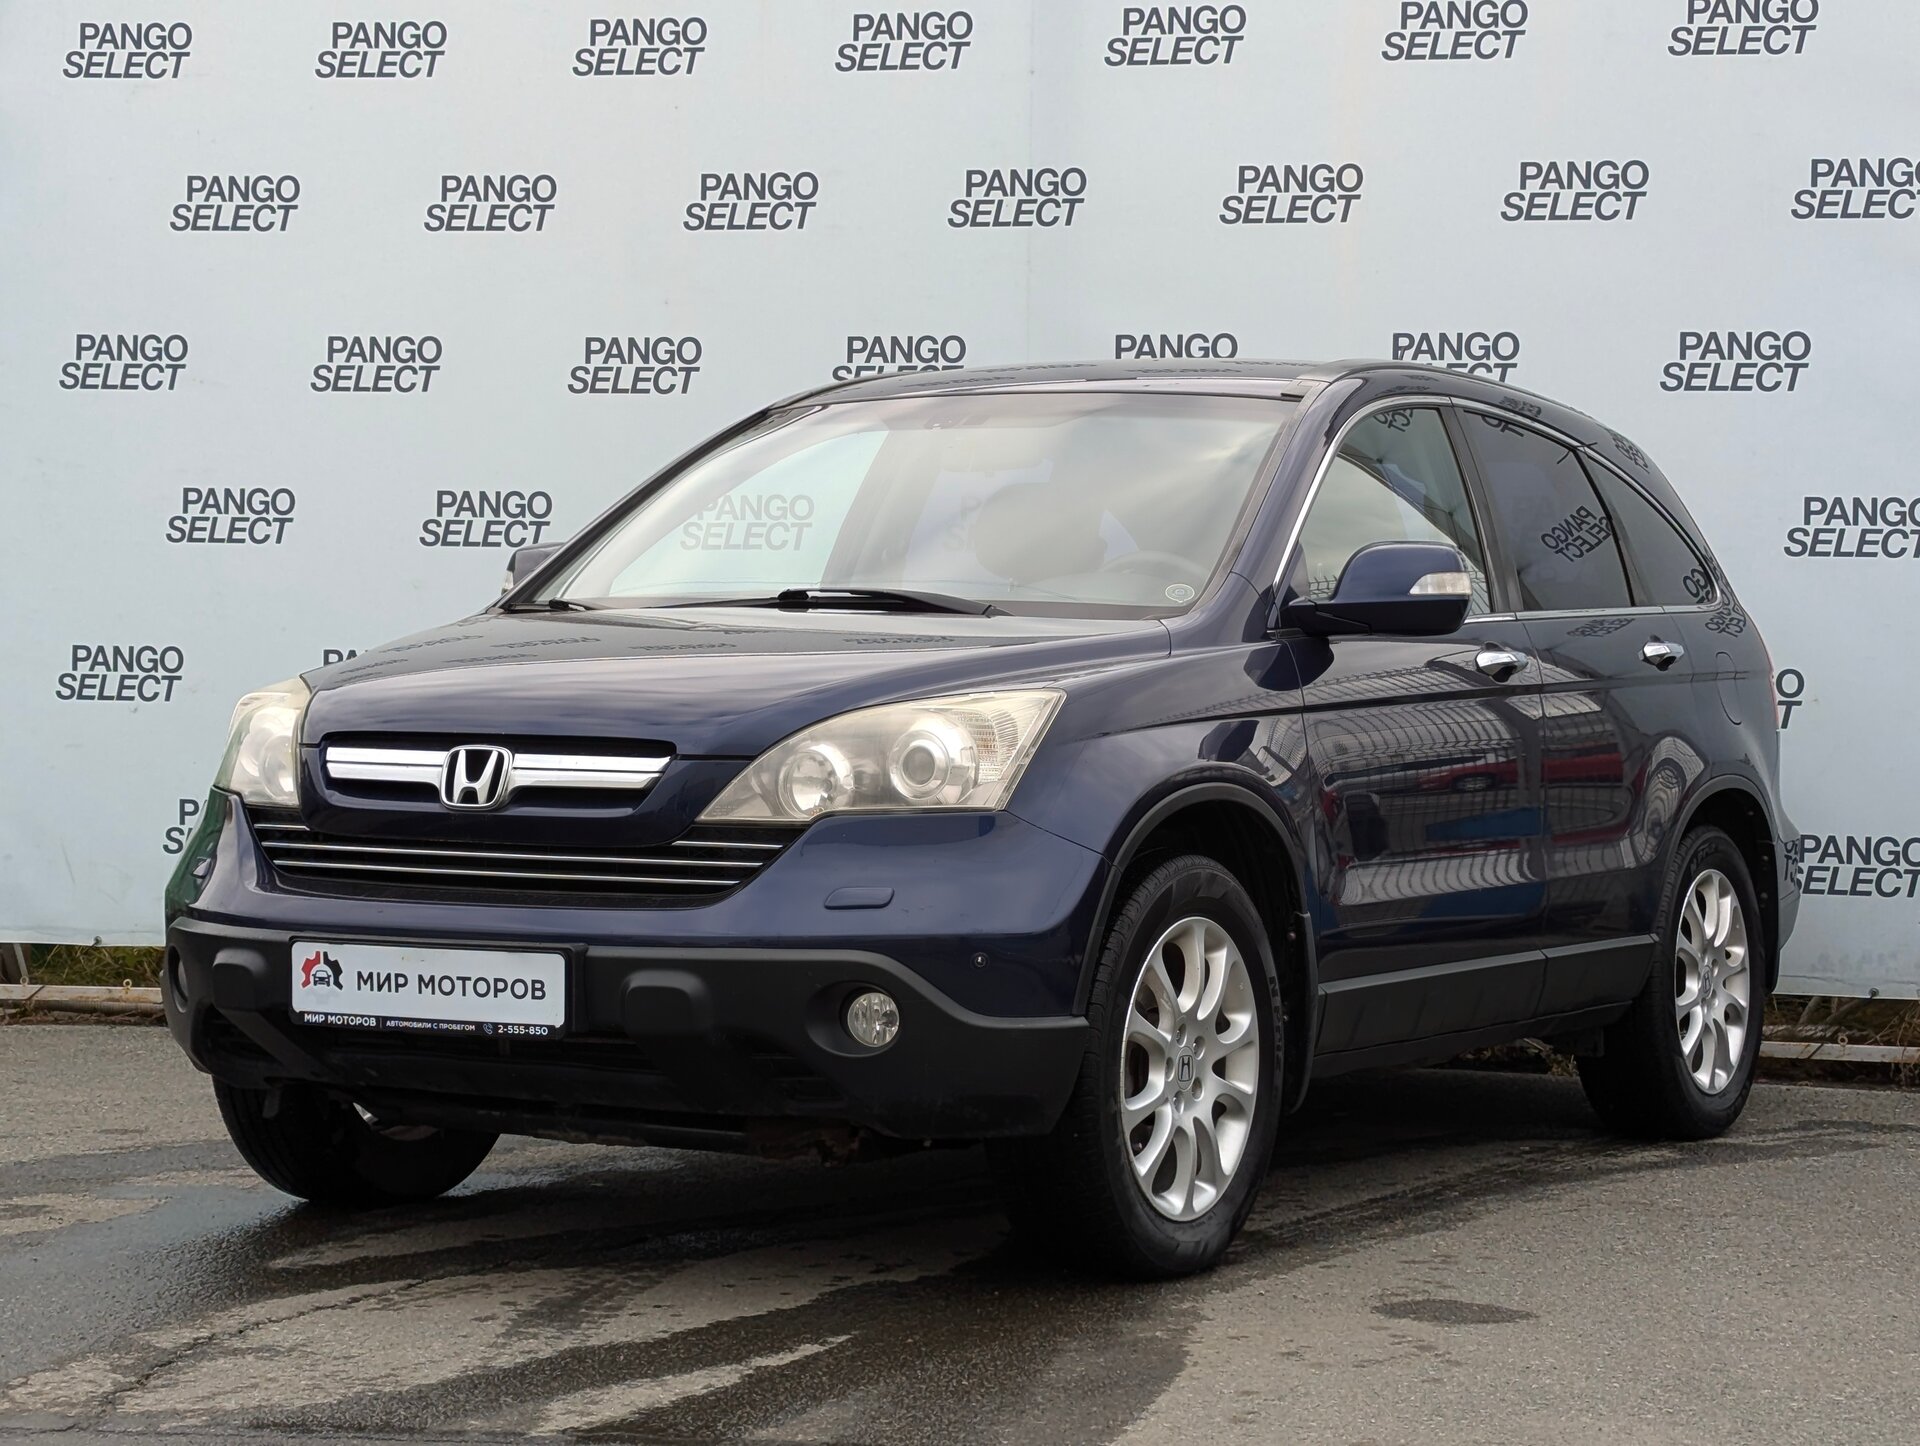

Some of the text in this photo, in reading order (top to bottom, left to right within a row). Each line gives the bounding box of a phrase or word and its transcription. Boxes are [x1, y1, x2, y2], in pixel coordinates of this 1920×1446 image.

[853, 11, 973, 41] PANGO
[1123, 5, 1246, 35] PANGO
[1401, 0, 1528, 30] PANGO
[1688, 0, 1818, 24] PANGO
[80, 23, 192, 50] PANGO
[332, 21, 447, 49] PANGO
[590, 17, 707, 46] PANGO
[1382, 30, 1526, 61] SELECT
[1668, 25, 1816, 56] SELECT
[63, 51, 190, 79] SELECT
[315, 50, 445, 78] SELECT
[573, 47, 705, 76] SELECT
[835, 41, 971, 72] SELECT
[1104, 36, 1244, 66] SELECT
[701, 172, 818, 201] PANGO
[966, 168, 1086, 197] PANGO
[1238, 164, 1363, 193] PANGO
[1520, 160, 1649, 190] PANGO
[1811, 158, 1920, 187] PANG
[187, 175, 300, 203] PANGO
[441, 175, 556, 202] PANGO
[170, 204, 298, 232] SELECT
[424, 204, 555, 231] SELECT
[683, 202, 816, 231] SELECT
[948, 198, 1084, 228] SELECT
[1219, 194, 1361, 224] SELECT
[1501, 191, 1647, 221] SELECT
[1791, 189, 1920, 219] SELEC
[76, 334, 188, 362] PANGO
[328, 336, 442, 363] PANGO
[585, 337, 702, 365] PANGO
[847, 335, 966, 363] PANGO
[1115, 333, 1238, 359] PANGO
[1391, 332, 1520, 361] PANGO
[1680, 331, 1811, 361] PANGO
[59, 362, 186, 390] SELECT
[311, 365, 440, 392] SELECT
[568, 366, 700, 394] SELECT
[1660, 362, 1809, 392] SELECT
[183, 488, 295, 515] PANGO
[437, 490, 552, 519] PANGO
[166, 516, 294, 544] SELECT
[419, 519, 551, 548] SELECT
[680, 522, 812, 551] SELECT
[72, 645, 183, 673] PANGO
[56, 673, 182, 702] SELECT
[357, 971, 546, 1001] МИР МОТОРОВ
[304, 1013, 325, 1025] МИР
[328, 1014, 377, 1027] МОТОРОВ
[386, 1020, 432, 1029] АВТОМОБИЛИ
[440, 1023, 476, 1032] ПРОБЕГОМ
[497, 1025, 548, 1036] 2-555-850
